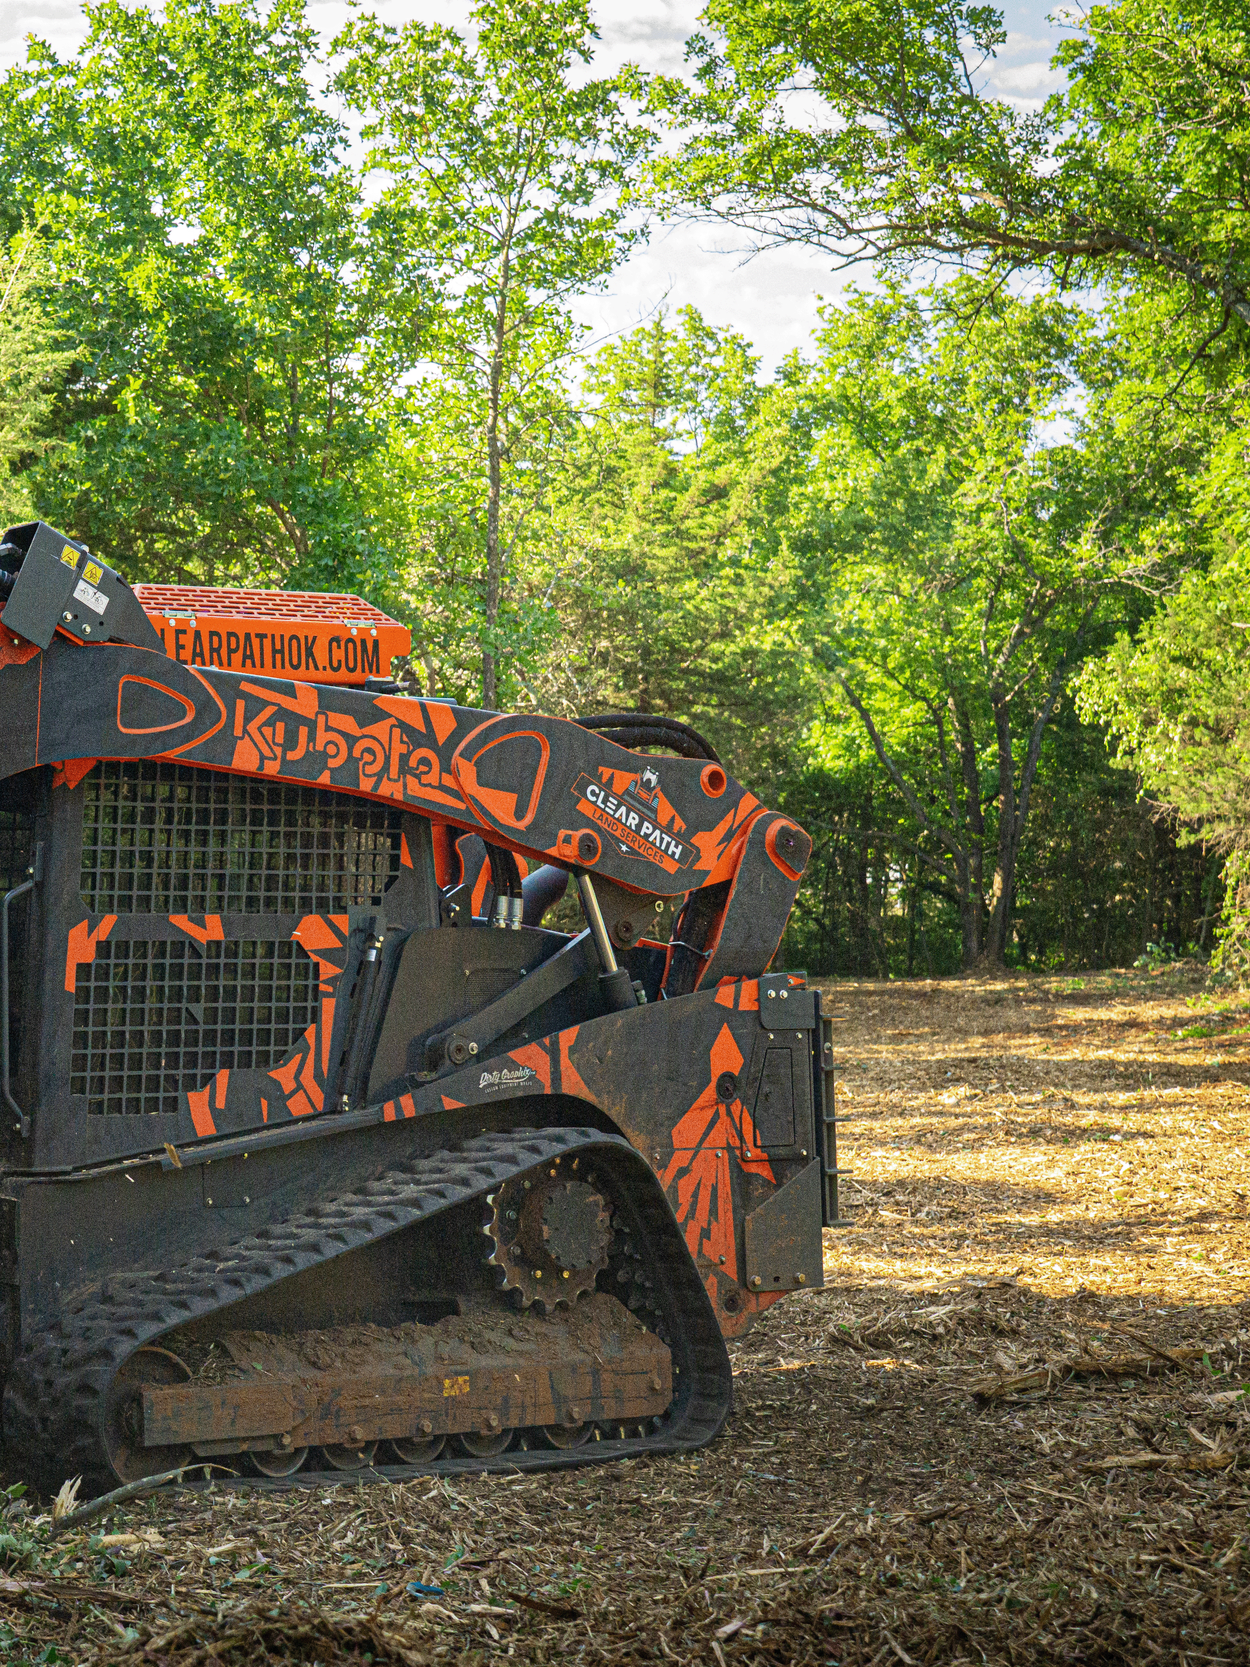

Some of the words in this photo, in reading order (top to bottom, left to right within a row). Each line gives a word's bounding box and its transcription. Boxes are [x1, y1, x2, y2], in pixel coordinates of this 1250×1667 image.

[233, 698, 441, 787] Kubota
[586, 784, 640, 831] CLEAR
[640, 820, 683, 860] PATH
[592, 809, 619, 832] LAND
[619, 829, 665, 864] SERVICES
[479, 1070, 500, 1084] Dirty
